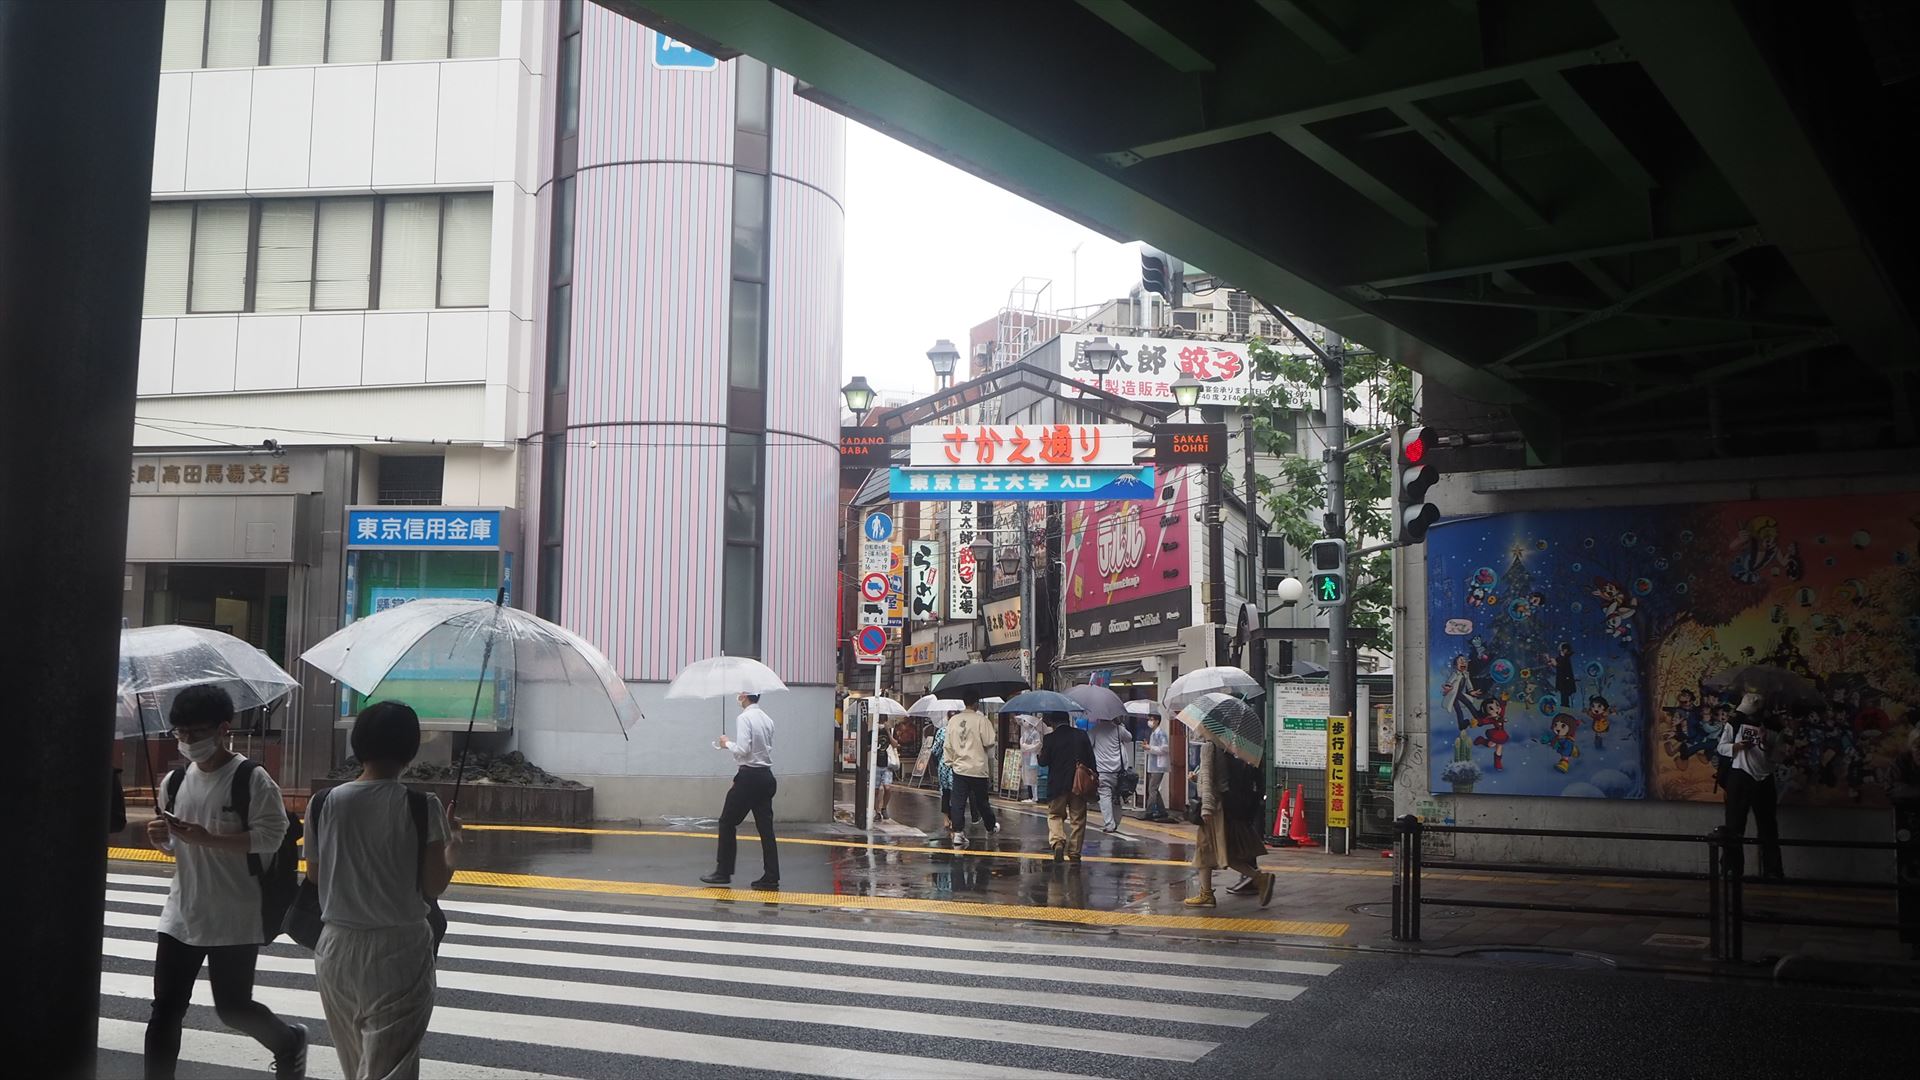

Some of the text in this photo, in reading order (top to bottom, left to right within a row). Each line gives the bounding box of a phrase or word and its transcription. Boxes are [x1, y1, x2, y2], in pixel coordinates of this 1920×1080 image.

[943, 425, 1101, 463] さかえ通り
[1173, 434, 1209, 443] SAKAE
[1174, 444, 1209, 453] DOHRI
[840, 447, 869, 455] BABA
[909, 473, 1092, 491] 東京富士大学 入口
[357, 517, 493, 541] 東京信用金庫
[913, 544, 938, 616] らーめん
[1331, 721, 1345, 812] 歩行者に注意
